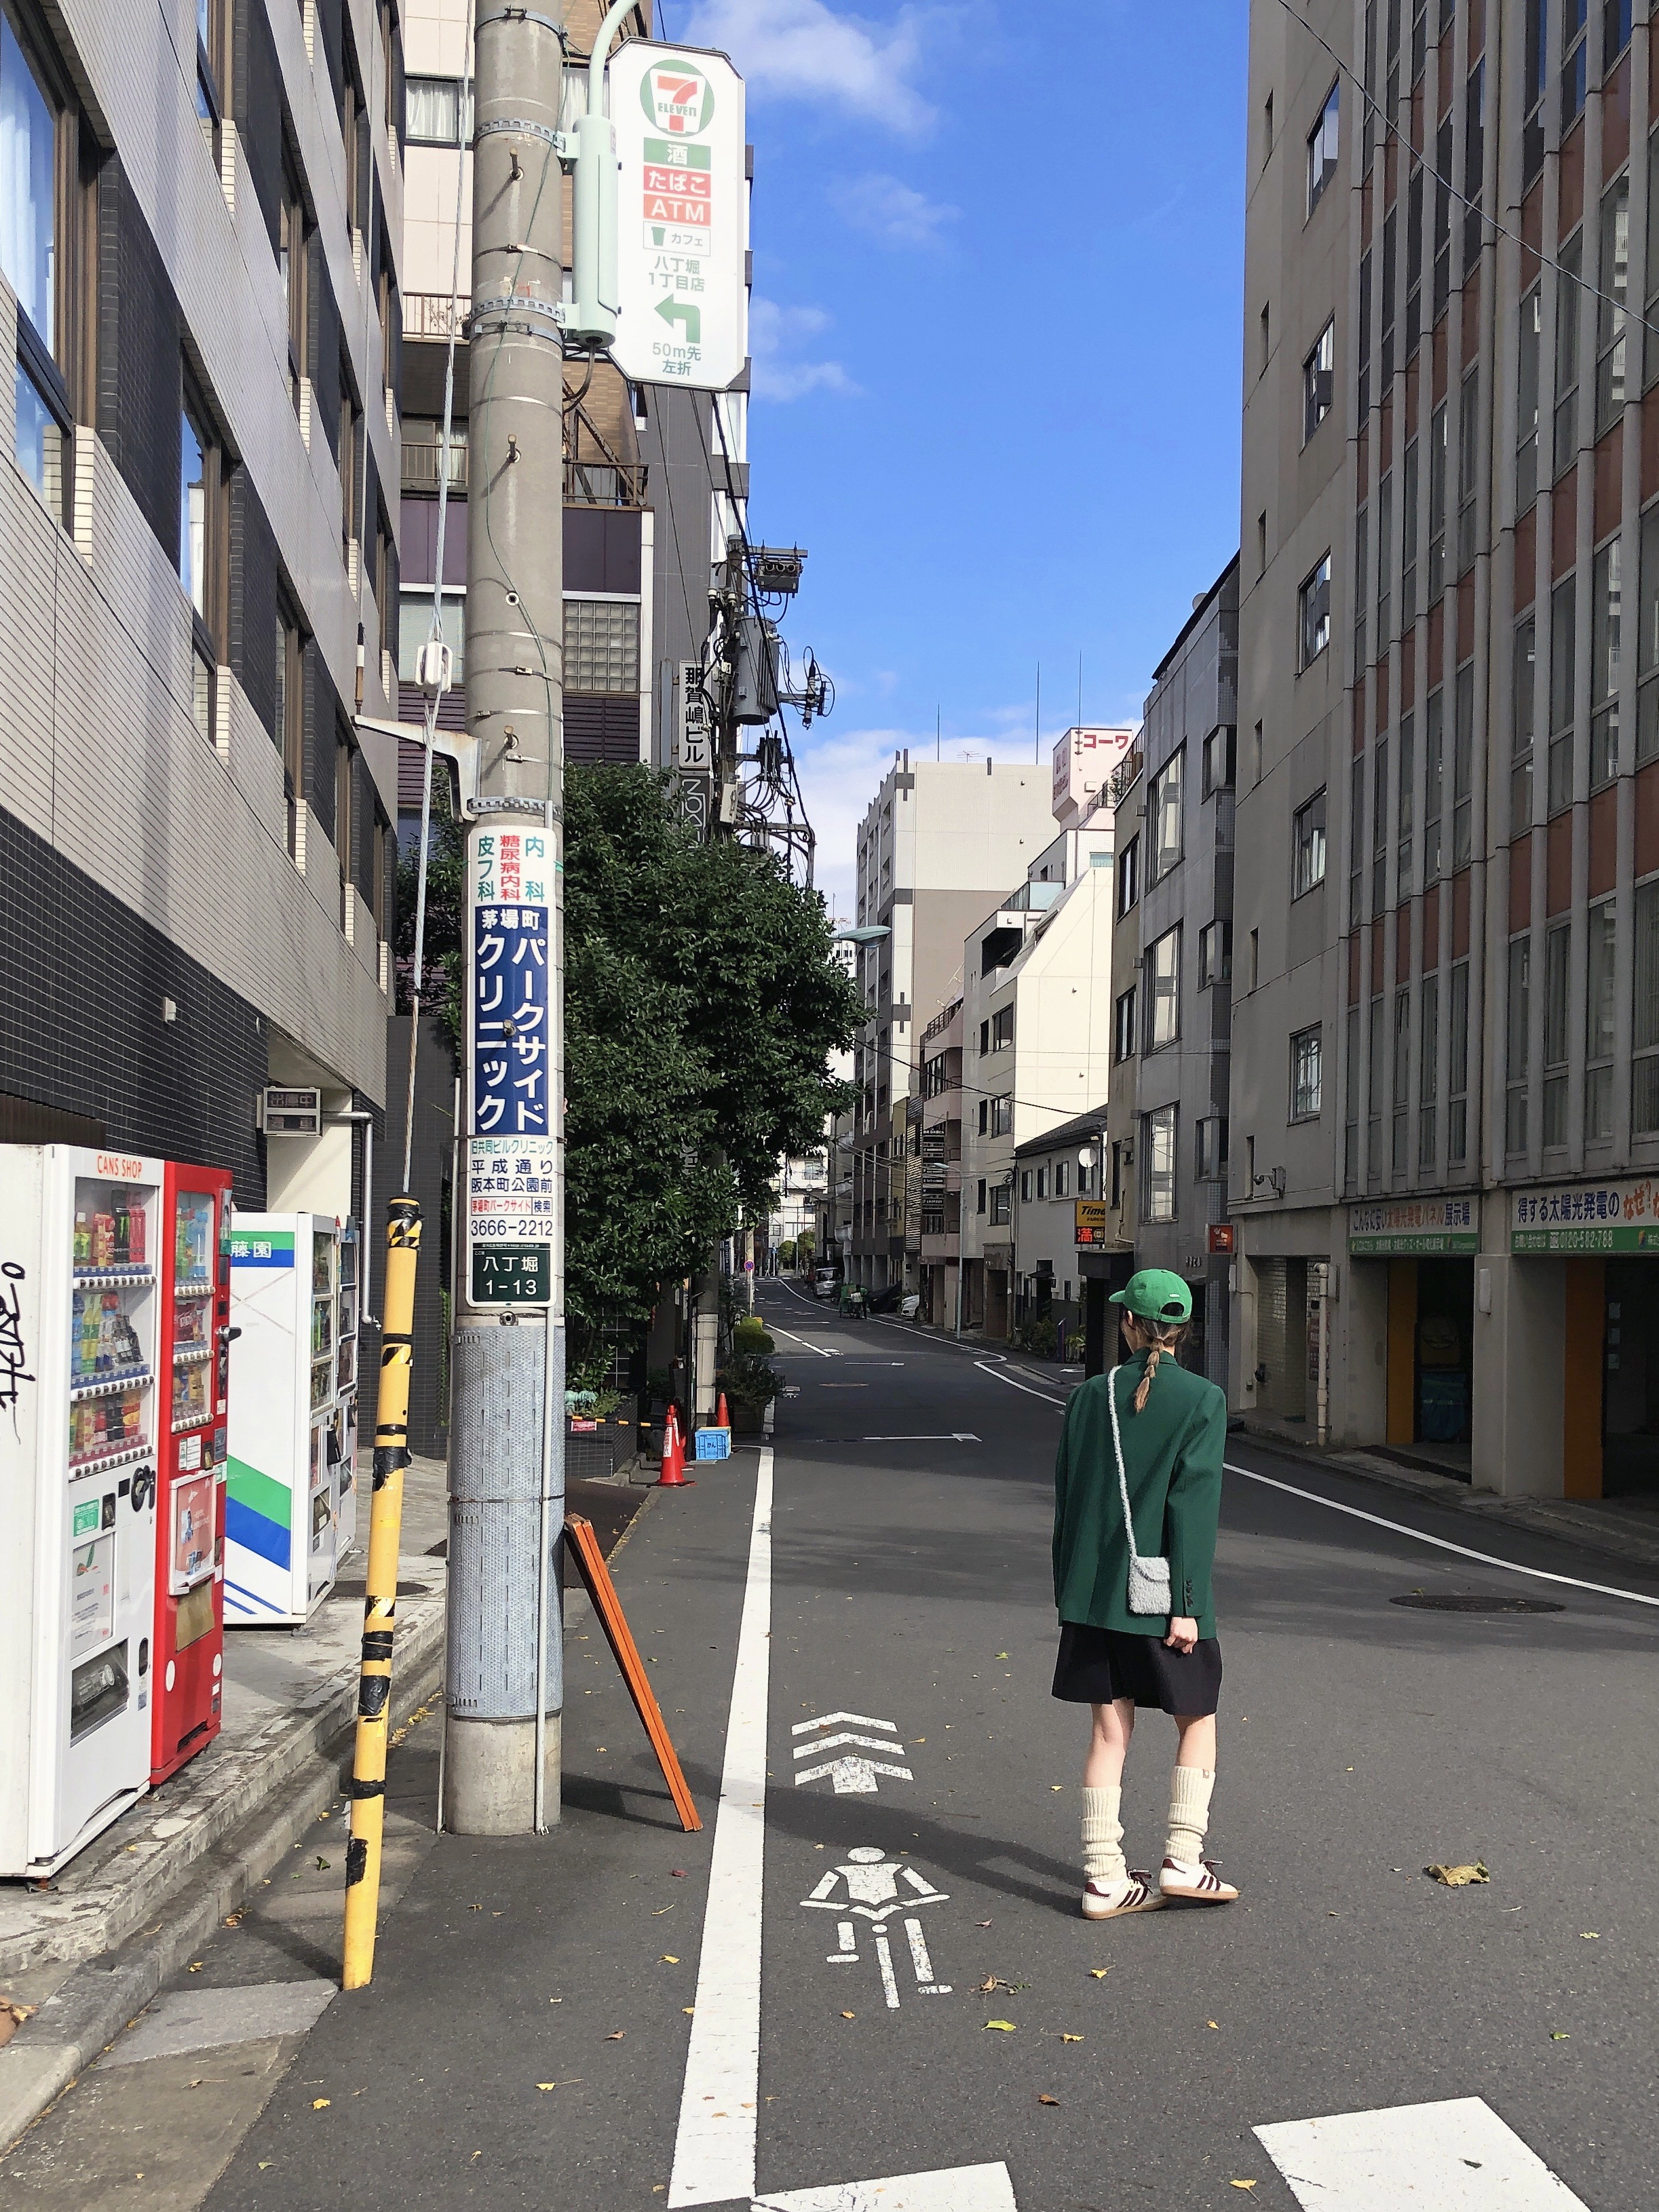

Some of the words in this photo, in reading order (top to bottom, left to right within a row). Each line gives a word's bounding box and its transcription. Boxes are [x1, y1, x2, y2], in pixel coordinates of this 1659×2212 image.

[657, 75, 698, 132] 7
[667, 143, 688, 165] 酒
[649, 170, 706, 194] たばこ
[651, 199, 704, 222] ATM
[671, 233, 703, 246] カフェ
[654, 256, 700, 275] 八丁堀
[649, 272, 705, 292] 1丁目店
[652, 342, 702, 361] 50m先
[662, 360, 692, 376] 左折
[1084, 735, 1128, 750] コーワ
[477, 835, 495, 902] 皮フ科
[499, 835, 521, 901] 糖尿病内科
[525, 837, 545, 902] 内科
[482, 909, 540, 931] 茅場町
[476, 934, 508, 1131] クリニック
[511, 937, 546, 1131] パークサイド
[97, 1155, 120, 1175] CANS
[122, 1160, 142, 1179] SHOP
[471, 1158, 553, 1175] 平成通り
[534, 1200, 551, 1213] 検索
[471, 1220, 553, 1236] 3666-2212
[1078, 1227, 1093, 1242] 満
[482, 1256, 538, 1272] 八丁堀
[485, 1279, 537, 1295] 1-13
